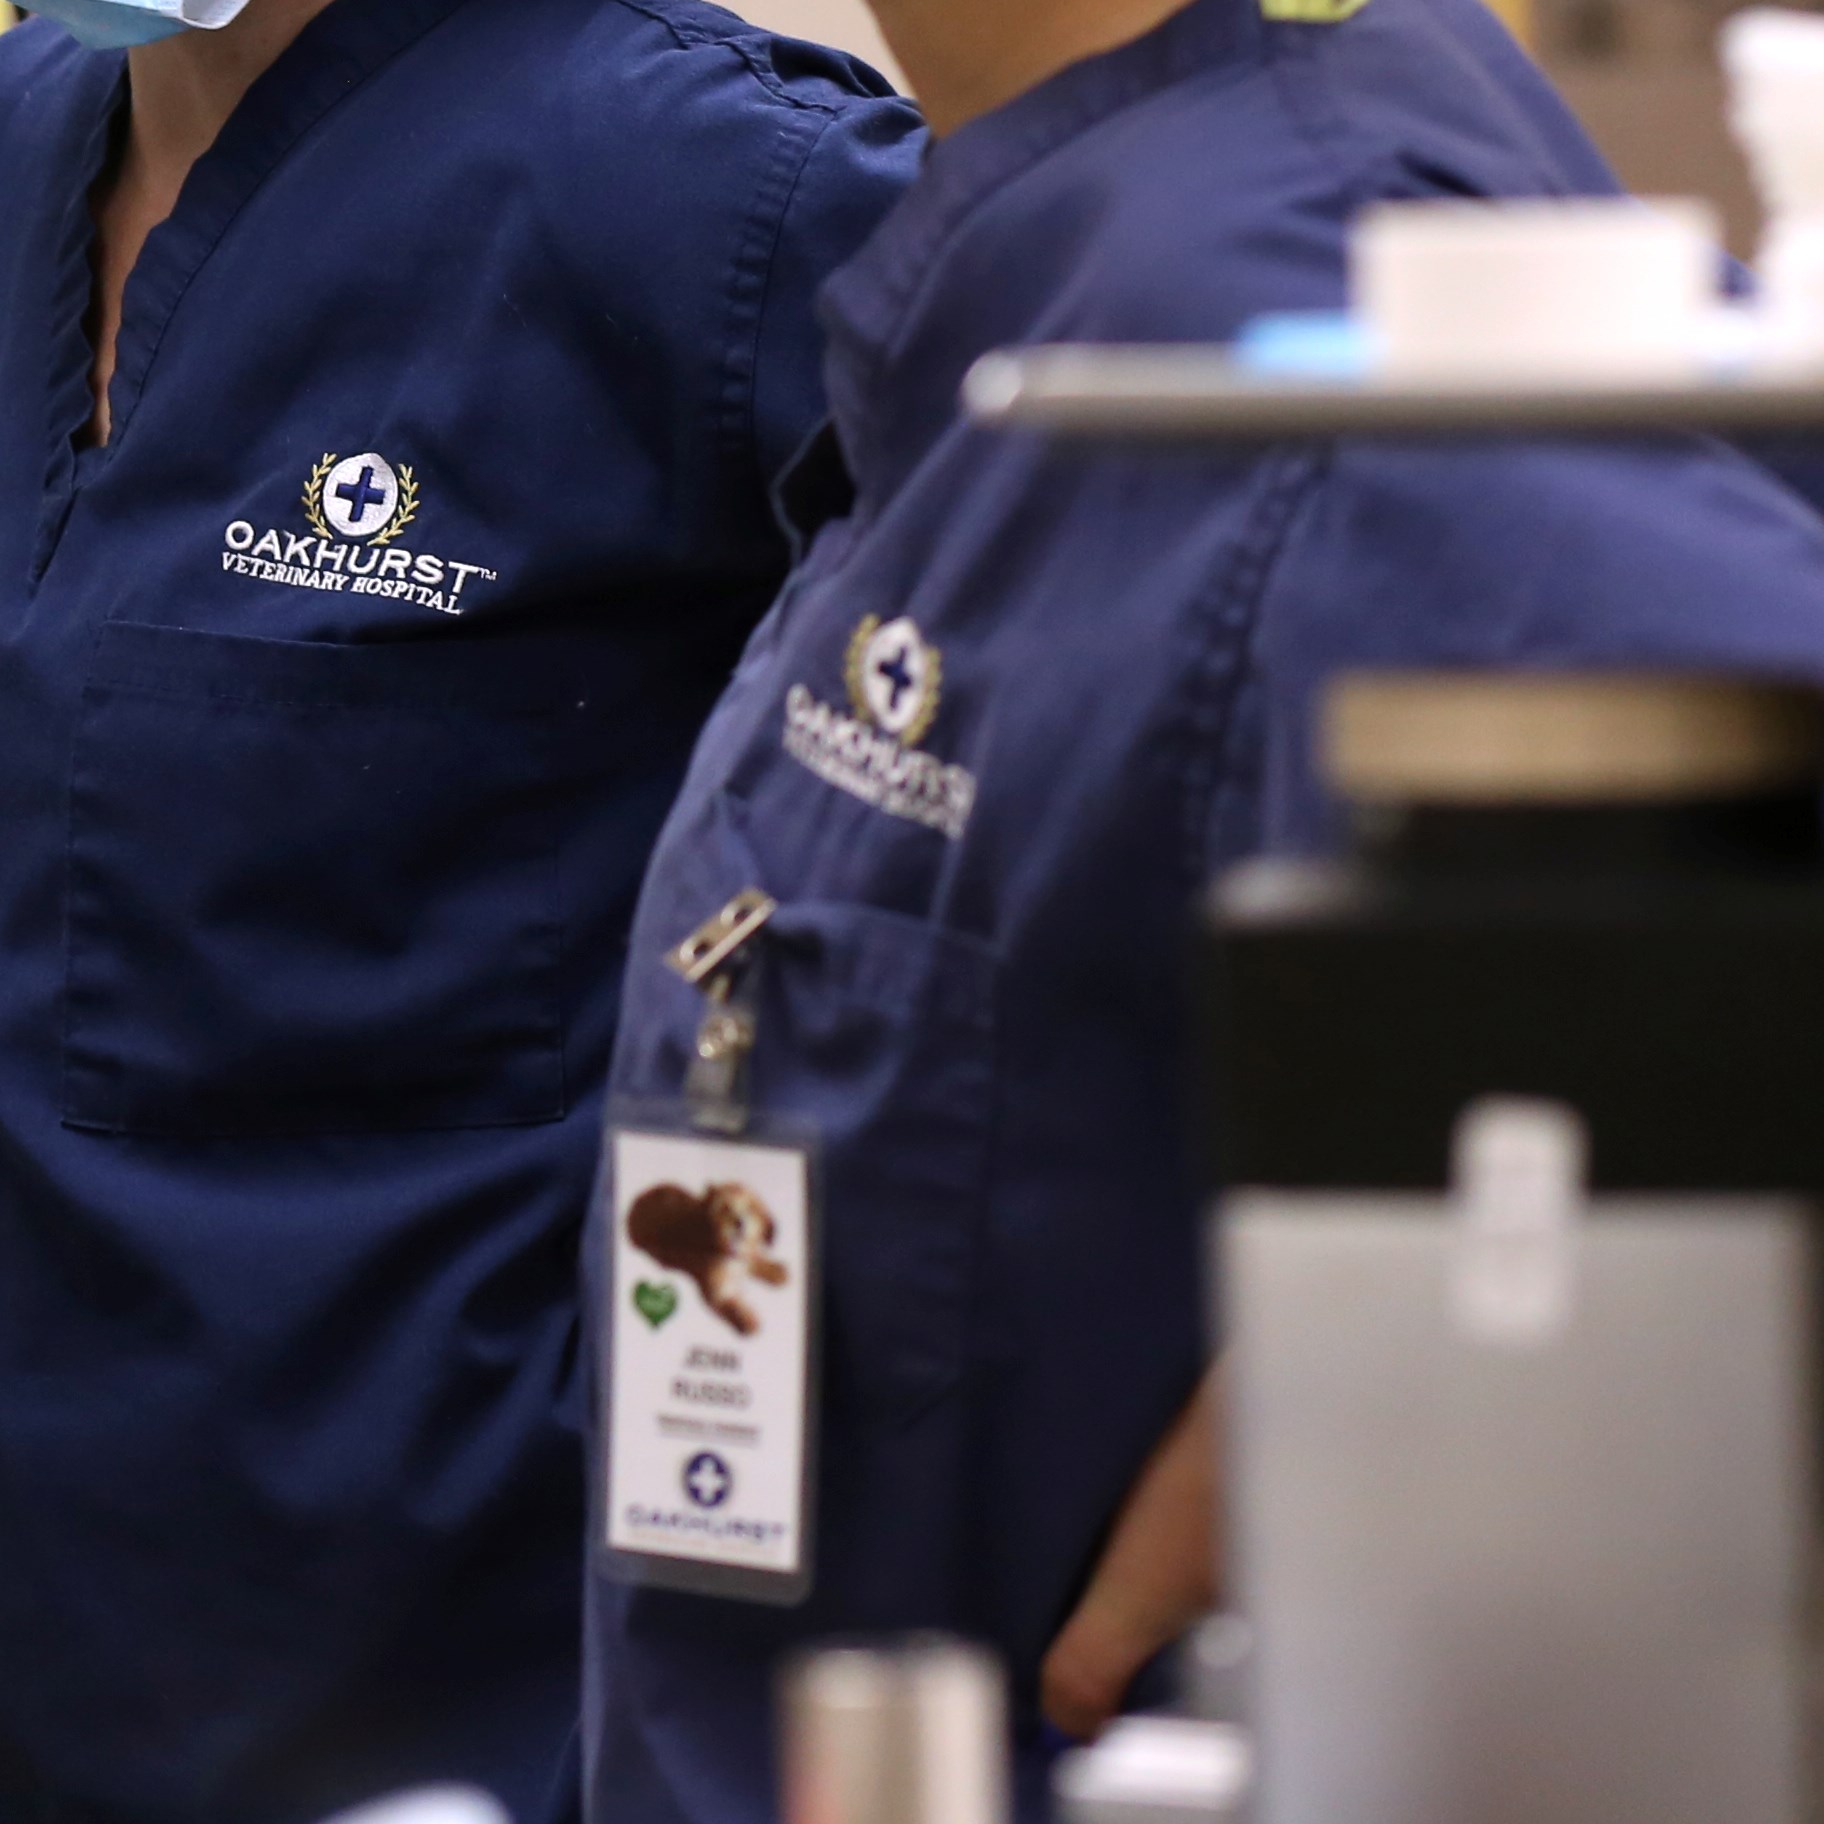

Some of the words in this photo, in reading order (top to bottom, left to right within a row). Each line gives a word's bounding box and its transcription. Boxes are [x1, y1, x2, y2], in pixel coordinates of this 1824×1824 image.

[221, 551, 348, 592] VETERINARY
[352, 577, 464, 615] HOSPITAL
[224, 520, 479, 594] OAKHURST
